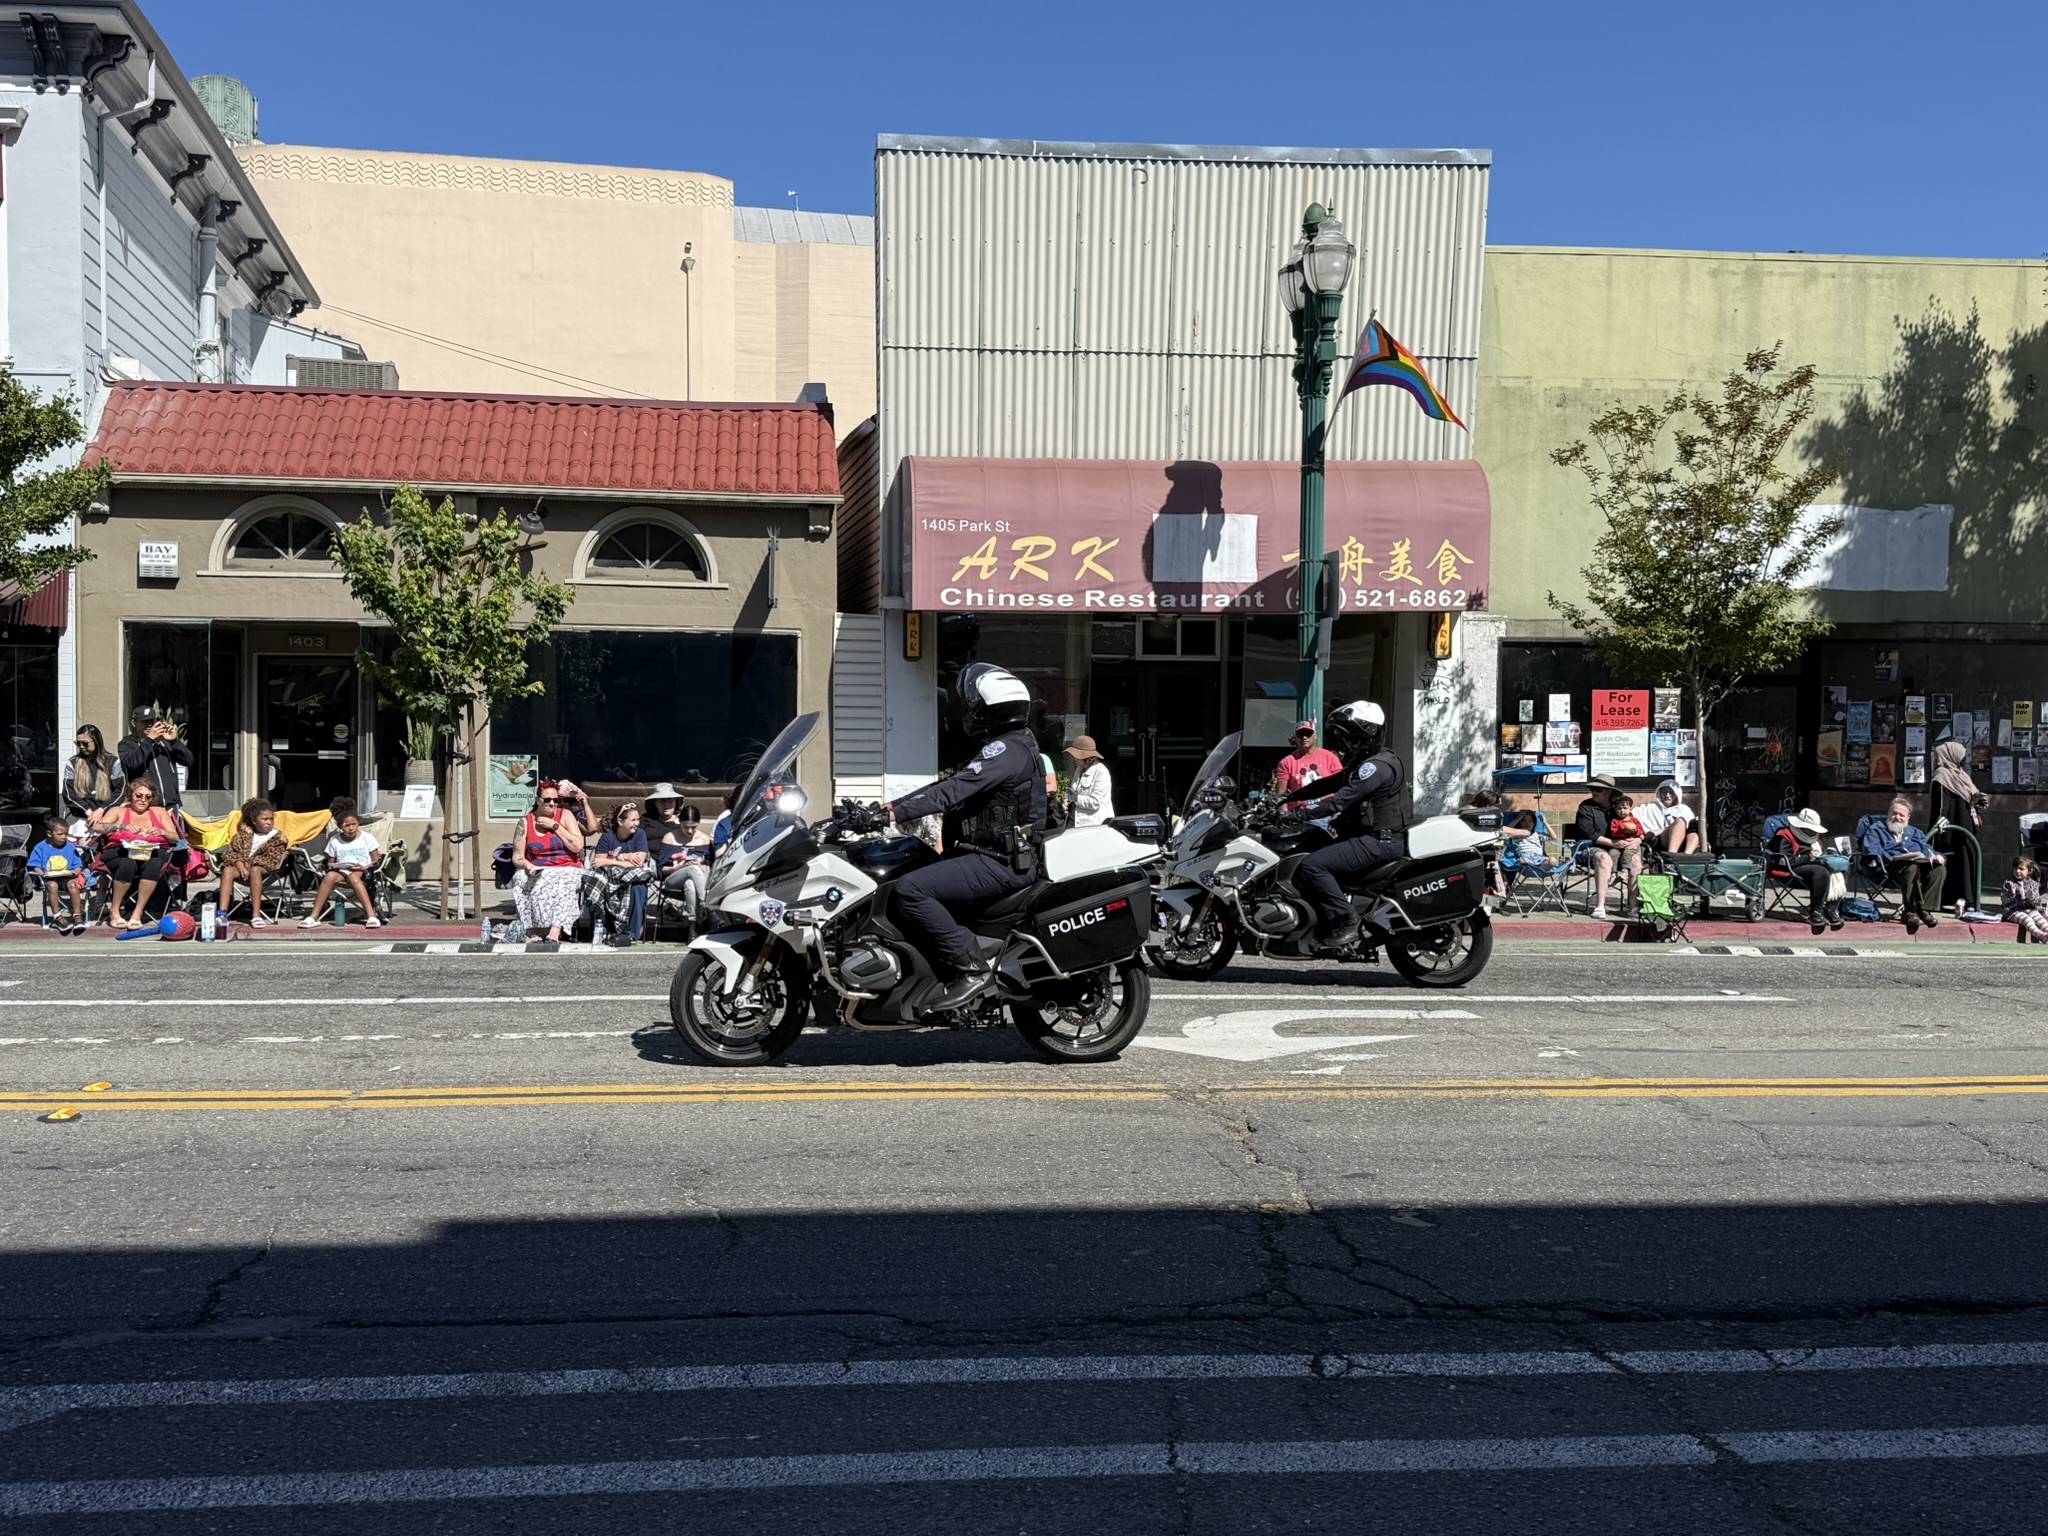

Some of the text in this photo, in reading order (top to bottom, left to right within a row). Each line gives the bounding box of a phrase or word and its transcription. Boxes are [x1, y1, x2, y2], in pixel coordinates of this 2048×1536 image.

[921, 518, 1010, 533] 1405 Park St
[145, 545, 173, 554] BAY
[951, 535, 1120, 582] ARK
[940, 587, 1074, 607] Chinese
[1085, 589, 1265, 608] Restaurant
[1354, 589, 1467, 608] 521-6862
[288, 637, 325, 647] 1403
[909, 617, 918, 652] ARK
[1609, 691, 1633, 703] For
[1600, 704, 1641, 716] Lease
[1595, 719, 1646, 727] 415.395.7262
[721, 826, 760, 865] POLICE
[1403, 878, 1448, 900] POLICE
[1048, 907, 1106, 937] POLICE
